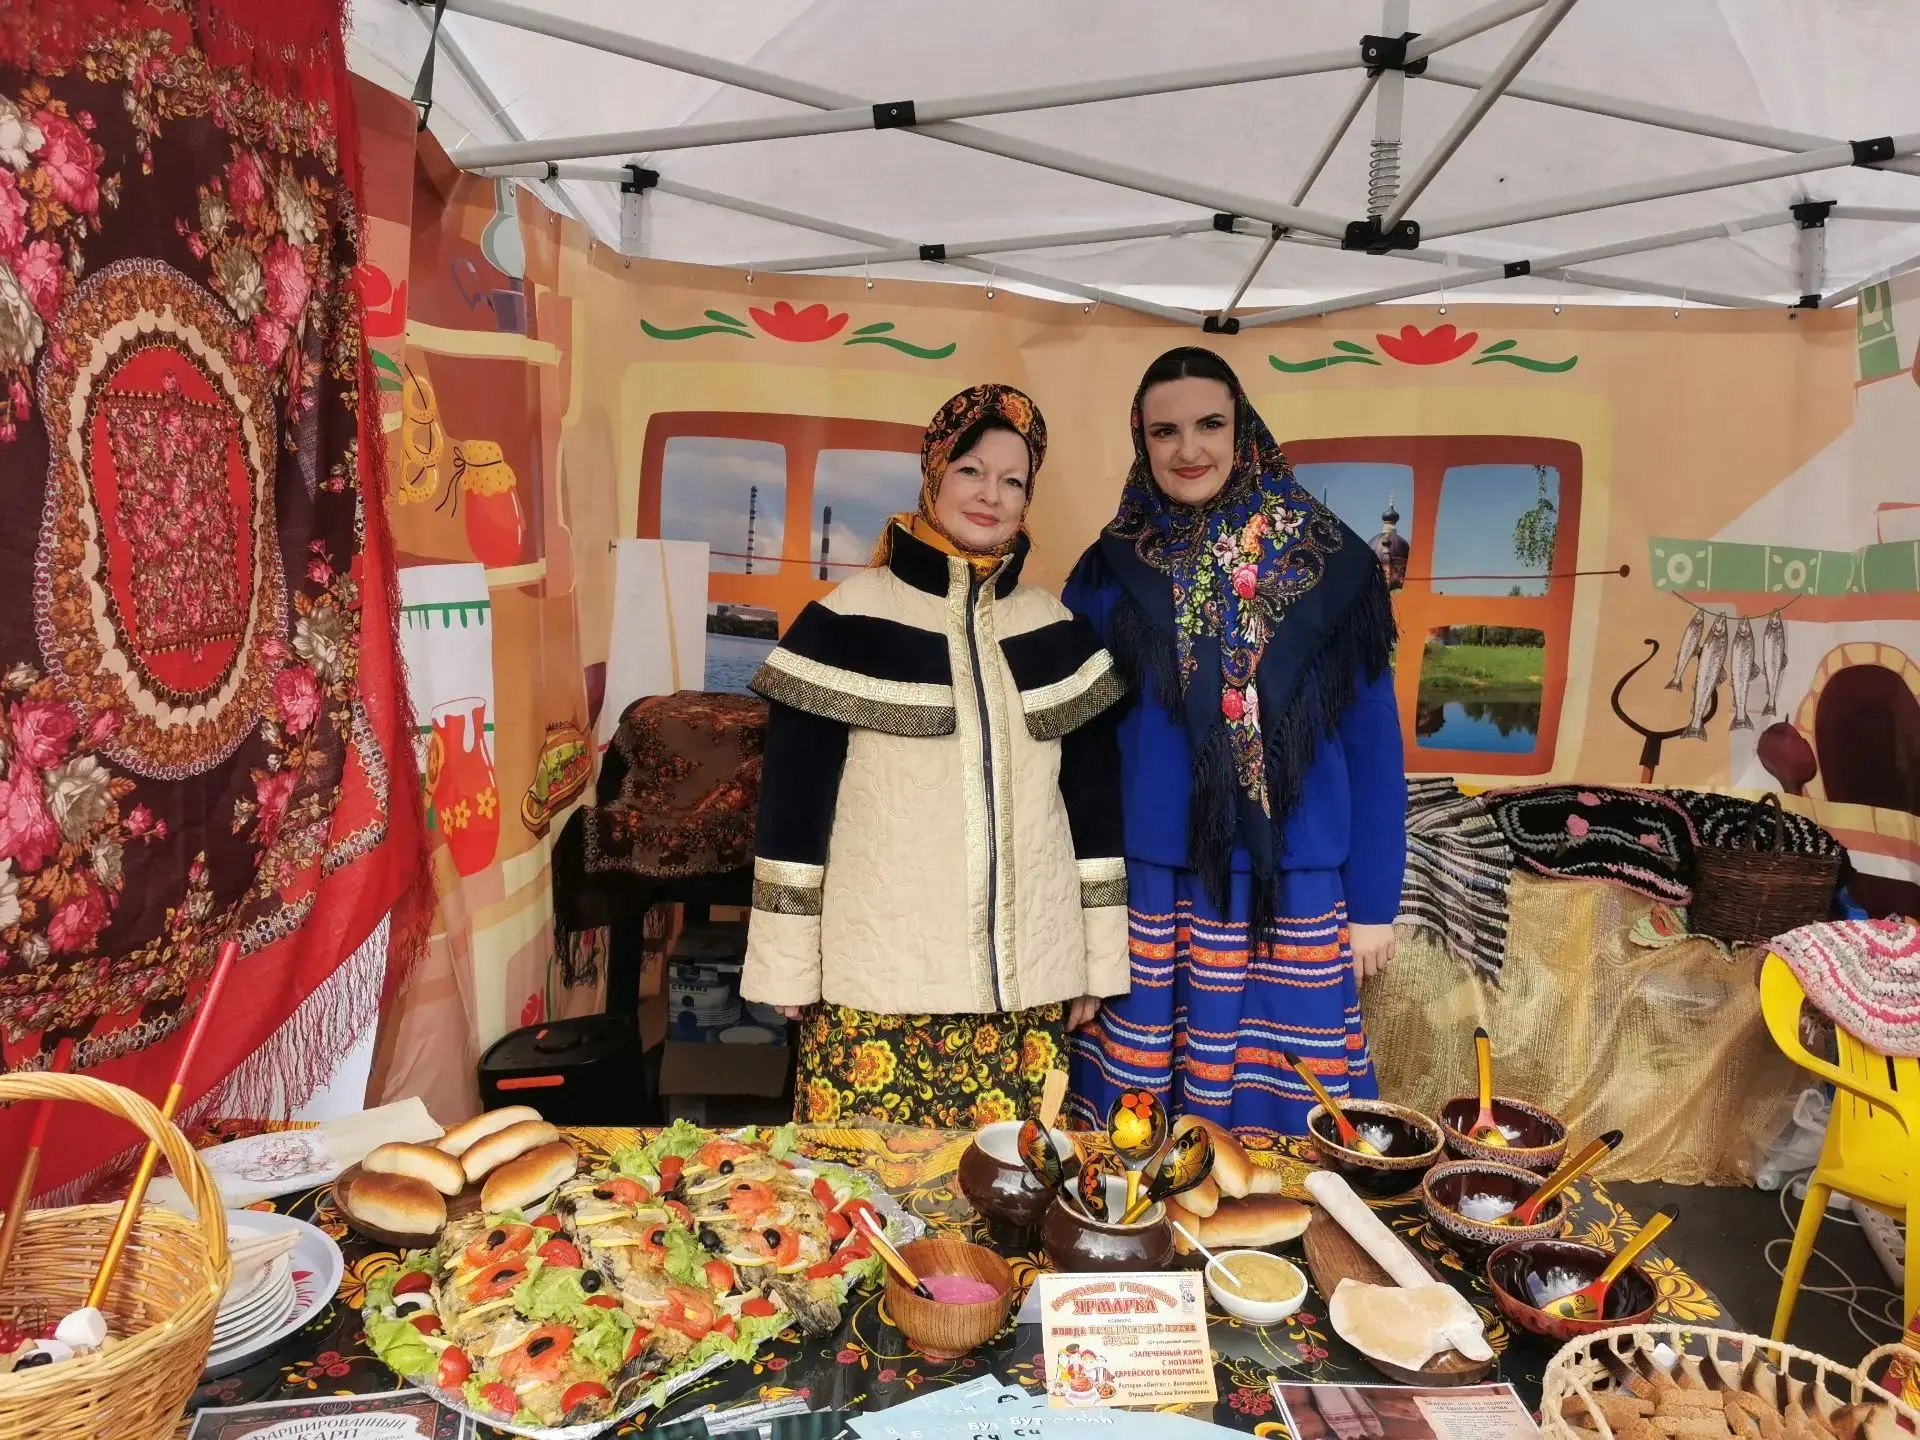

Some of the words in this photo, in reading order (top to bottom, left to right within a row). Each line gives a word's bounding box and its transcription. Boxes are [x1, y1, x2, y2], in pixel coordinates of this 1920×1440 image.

[1072, 1298, 1158, 1315] ЯРМАРКА
[1051, 1326, 1087, 1338] БЛЮДА
[1087, 1324, 1164, 1336] НАЦИОНАЛЬНОЙ
[1164, 1323, 1197, 1334] КУХНИ
[1102, 1335, 1139, 1346] РОССИИ
[1129, 1348, 1181, 1357] «ЗАПЕЧЕННЫЙ
[1183, 1348, 1203, 1356] КАРП
[1114, 1369, 1160, 1377] ЕВРЕЙСКОГО
[1161, 1368, 1205, 1376] КОЛОРИТА»
[297, 1429, 358, 1440] КАРП
